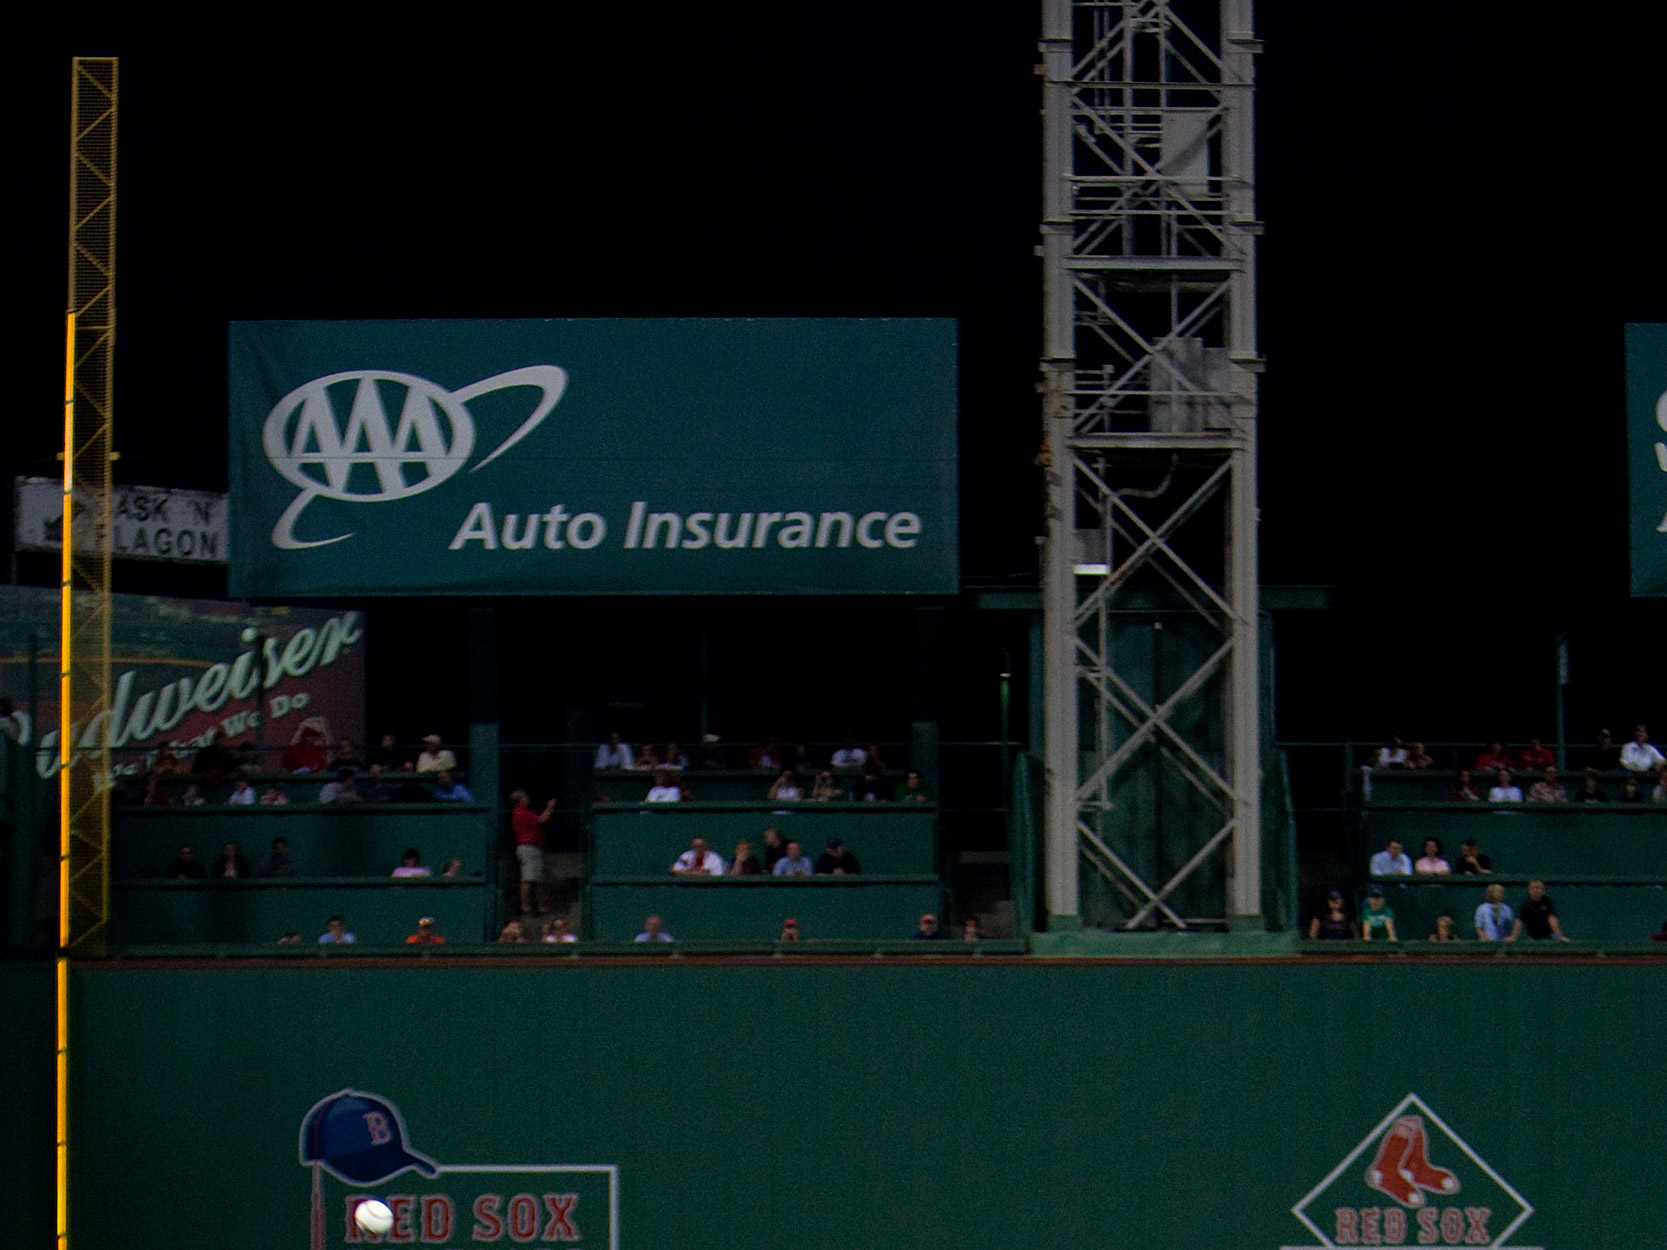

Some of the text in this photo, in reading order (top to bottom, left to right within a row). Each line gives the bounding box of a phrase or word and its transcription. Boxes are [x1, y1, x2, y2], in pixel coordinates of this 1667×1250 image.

[276, 374, 462, 498] AAA
[100, 524, 218, 559] LAGON
[448, 501, 923, 551] Auto Insurance
[471, 1192, 582, 1242] SOX
[1335, 1206, 1493, 1244] RED SOX
